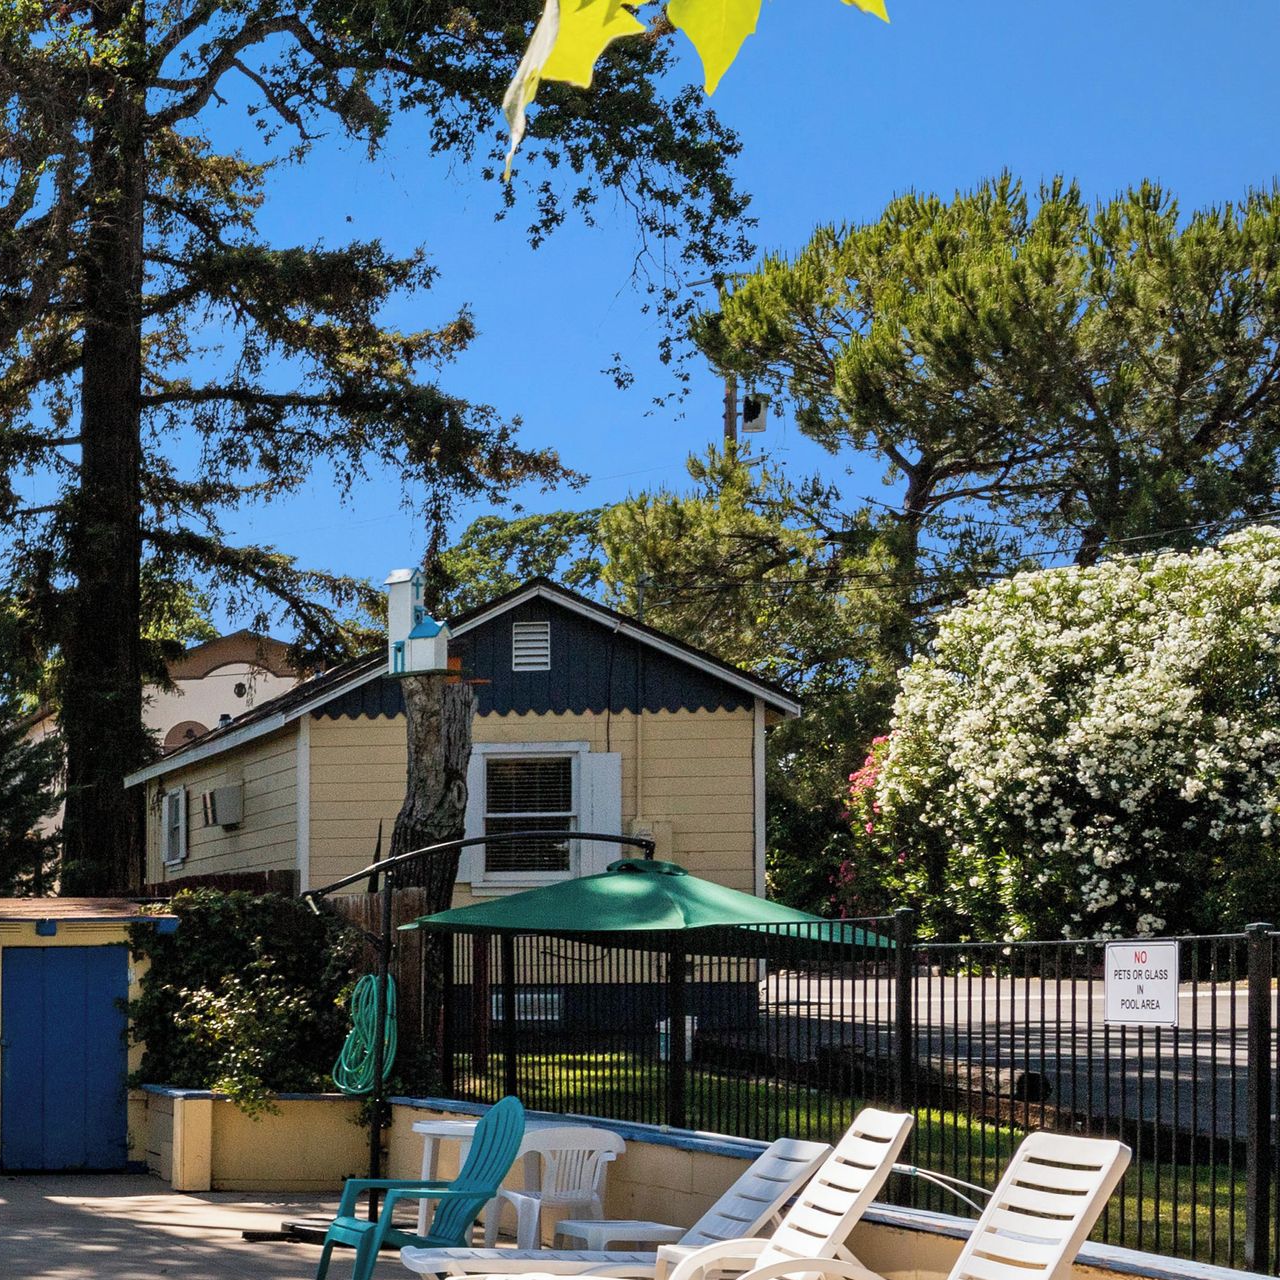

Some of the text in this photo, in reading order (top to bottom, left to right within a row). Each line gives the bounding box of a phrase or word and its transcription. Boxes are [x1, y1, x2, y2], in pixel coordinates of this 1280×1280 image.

[1134, 950, 1147, 964] NO
[1113, 969, 1169, 980] PETS OR GLASS
[1136, 984, 1144, 995] IN
[1120, 999, 1161, 1010] POOL AREA
